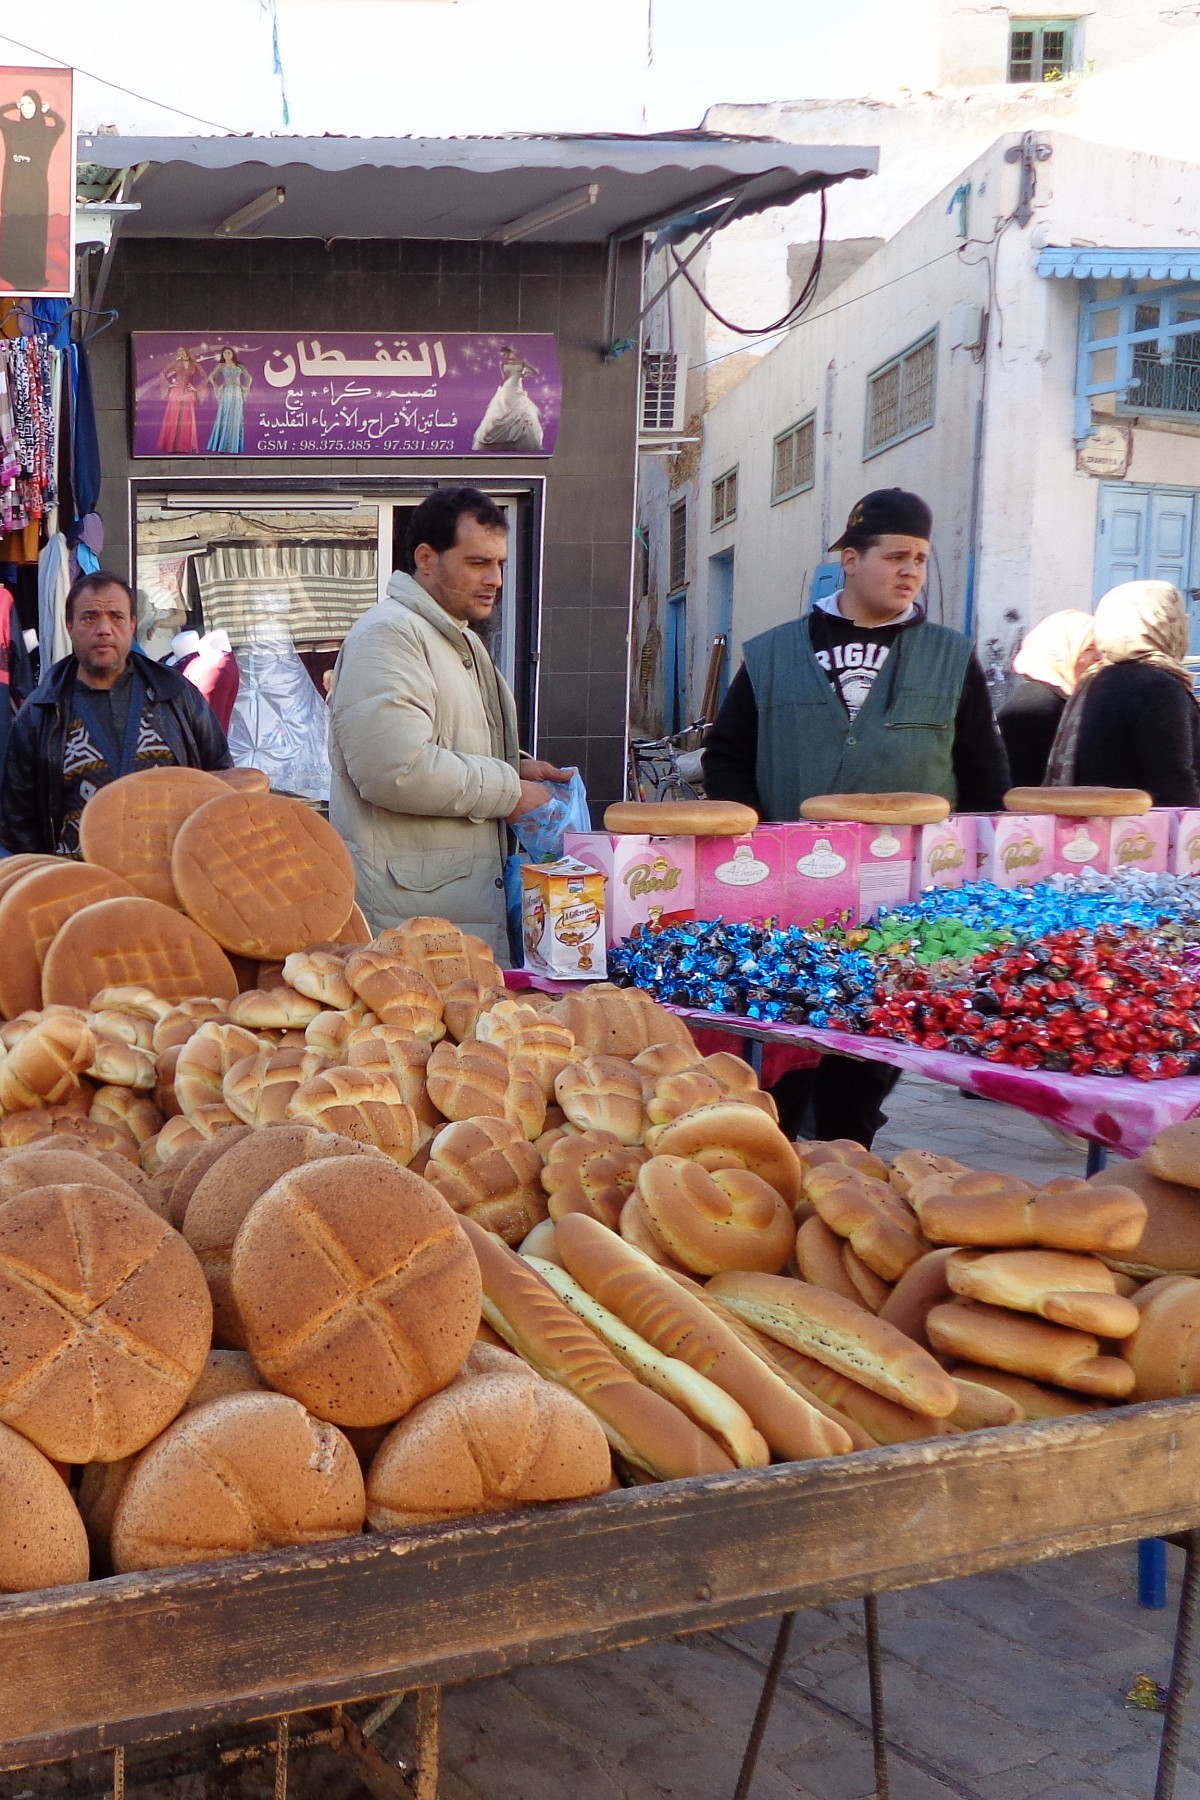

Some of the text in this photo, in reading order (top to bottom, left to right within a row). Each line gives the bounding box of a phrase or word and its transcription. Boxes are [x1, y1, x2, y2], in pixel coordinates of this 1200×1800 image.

[263, 339, 447, 388] القفطان
[285, 381, 438, 411] تصميم كراء بيع
[258, 410, 308, 437] التقليدية
[417, 409, 459, 434] فساتين
[257, 440, 288, 450] GSM
[300, 440, 371, 450] 98.375.385
[383, 440, 455, 450] 97.531.973
